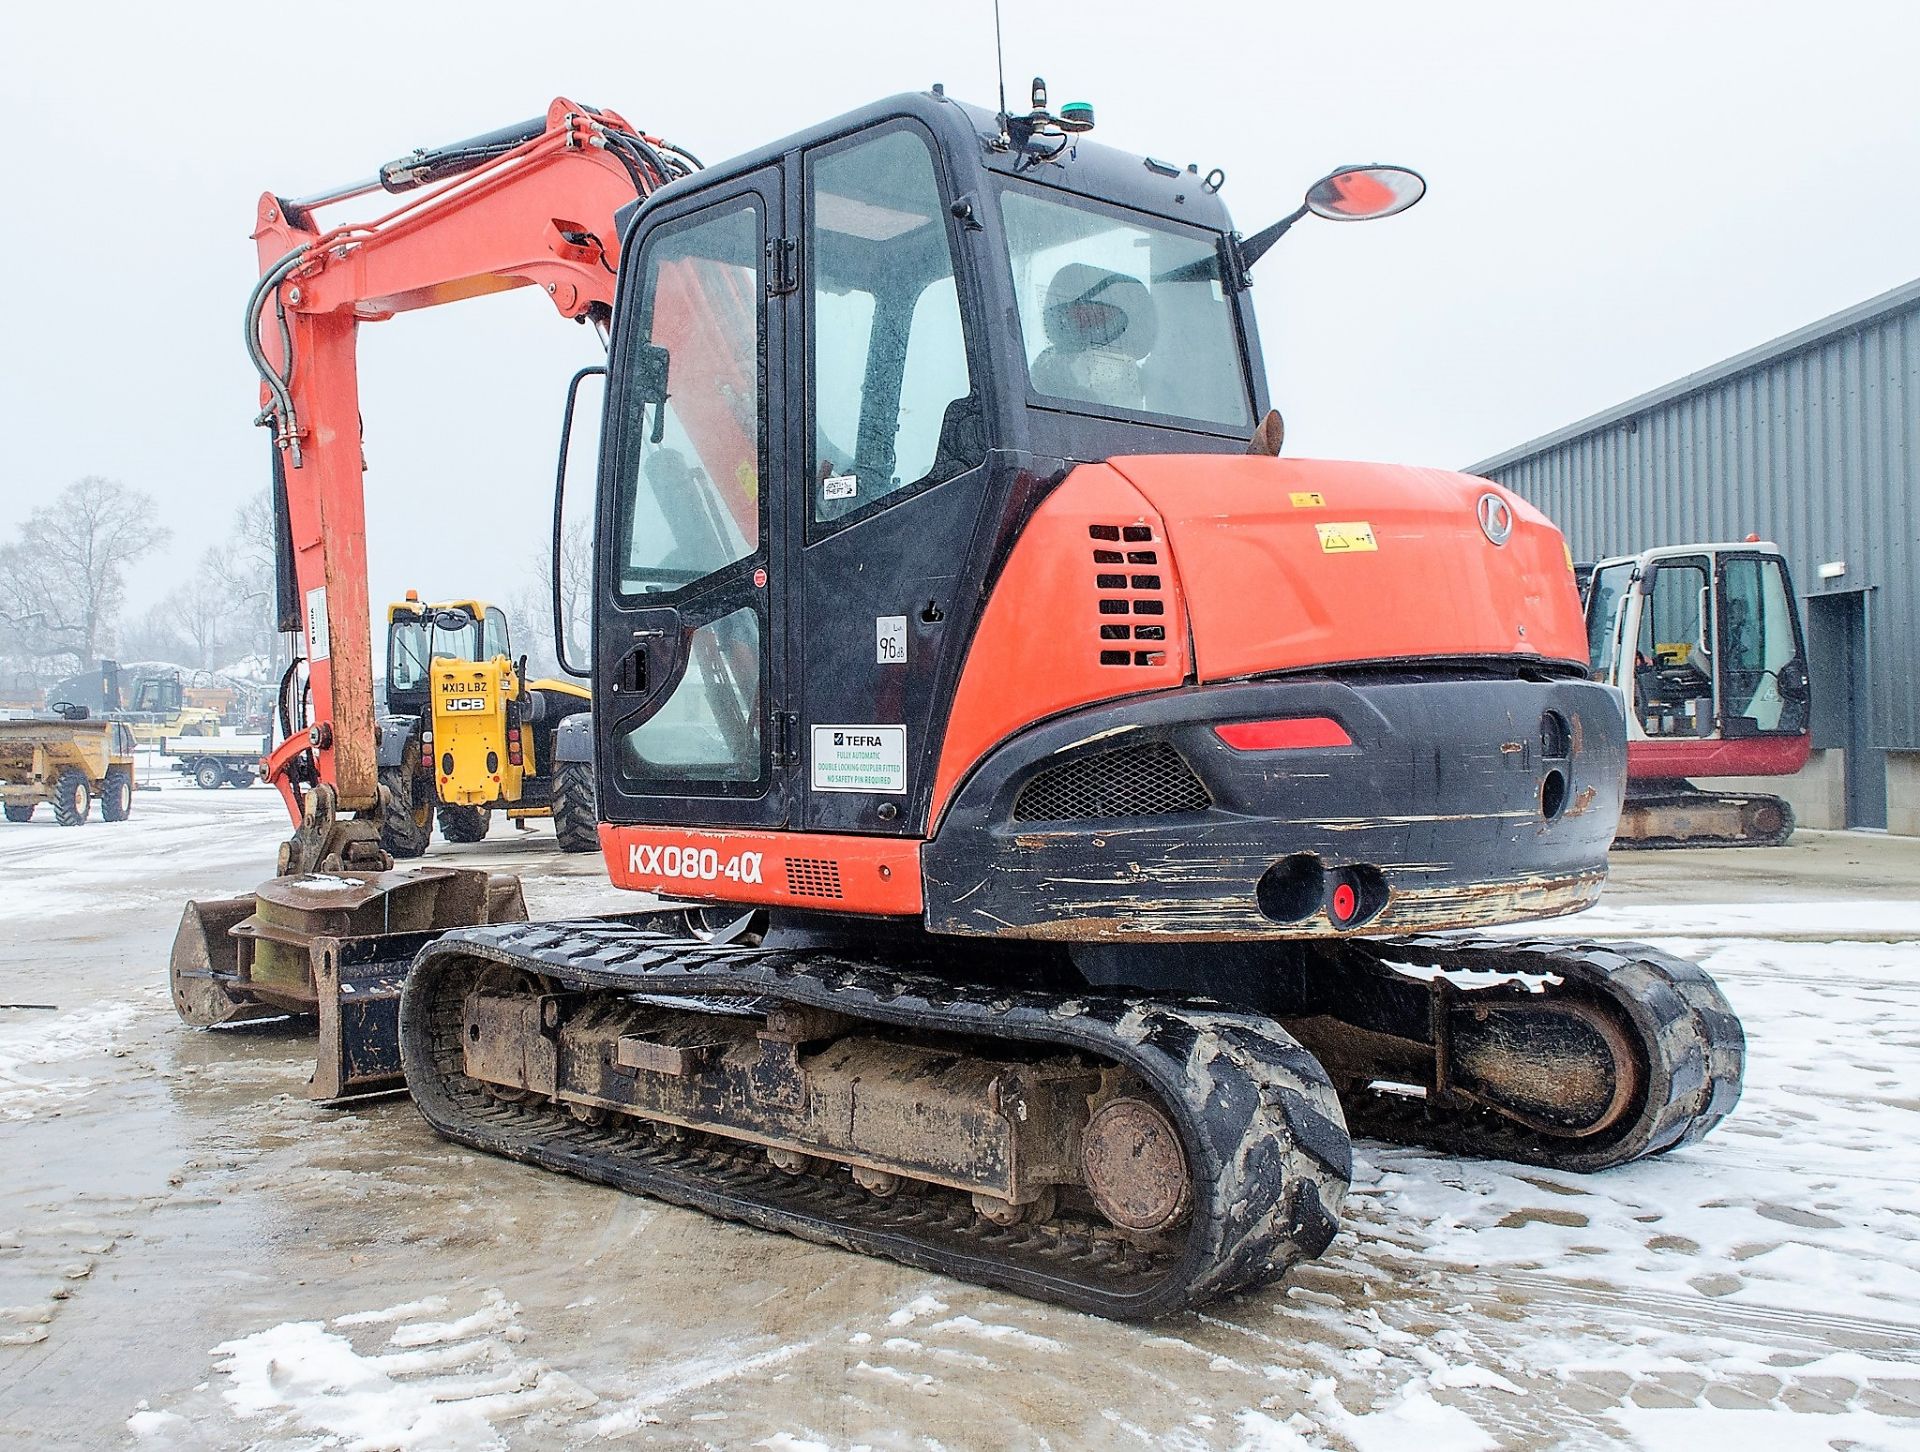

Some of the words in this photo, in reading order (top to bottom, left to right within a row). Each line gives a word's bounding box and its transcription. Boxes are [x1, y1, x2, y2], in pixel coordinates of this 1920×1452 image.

[880, 637, 895, 659] 96
[467, 682, 487, 692] LBZ
[446, 698, 485, 711] JCB
[846, 736, 881, 746] TEFRA
[837, 751, 852, 760] FULLY
[852, 751, 881, 760] AUTOMATIC
[818, 762, 837, 771] DOUBLE
[838, 763, 859, 772] LOCKING
[860, 763, 882, 773] COUPLER
[883, 764, 901, 773] FITTED
[827, 775, 835, 783] NO
[835, 775, 854, 784] SAFETY
[854, 776, 864, 784] PIN
[864, 776, 892, 785] REQUIRED
